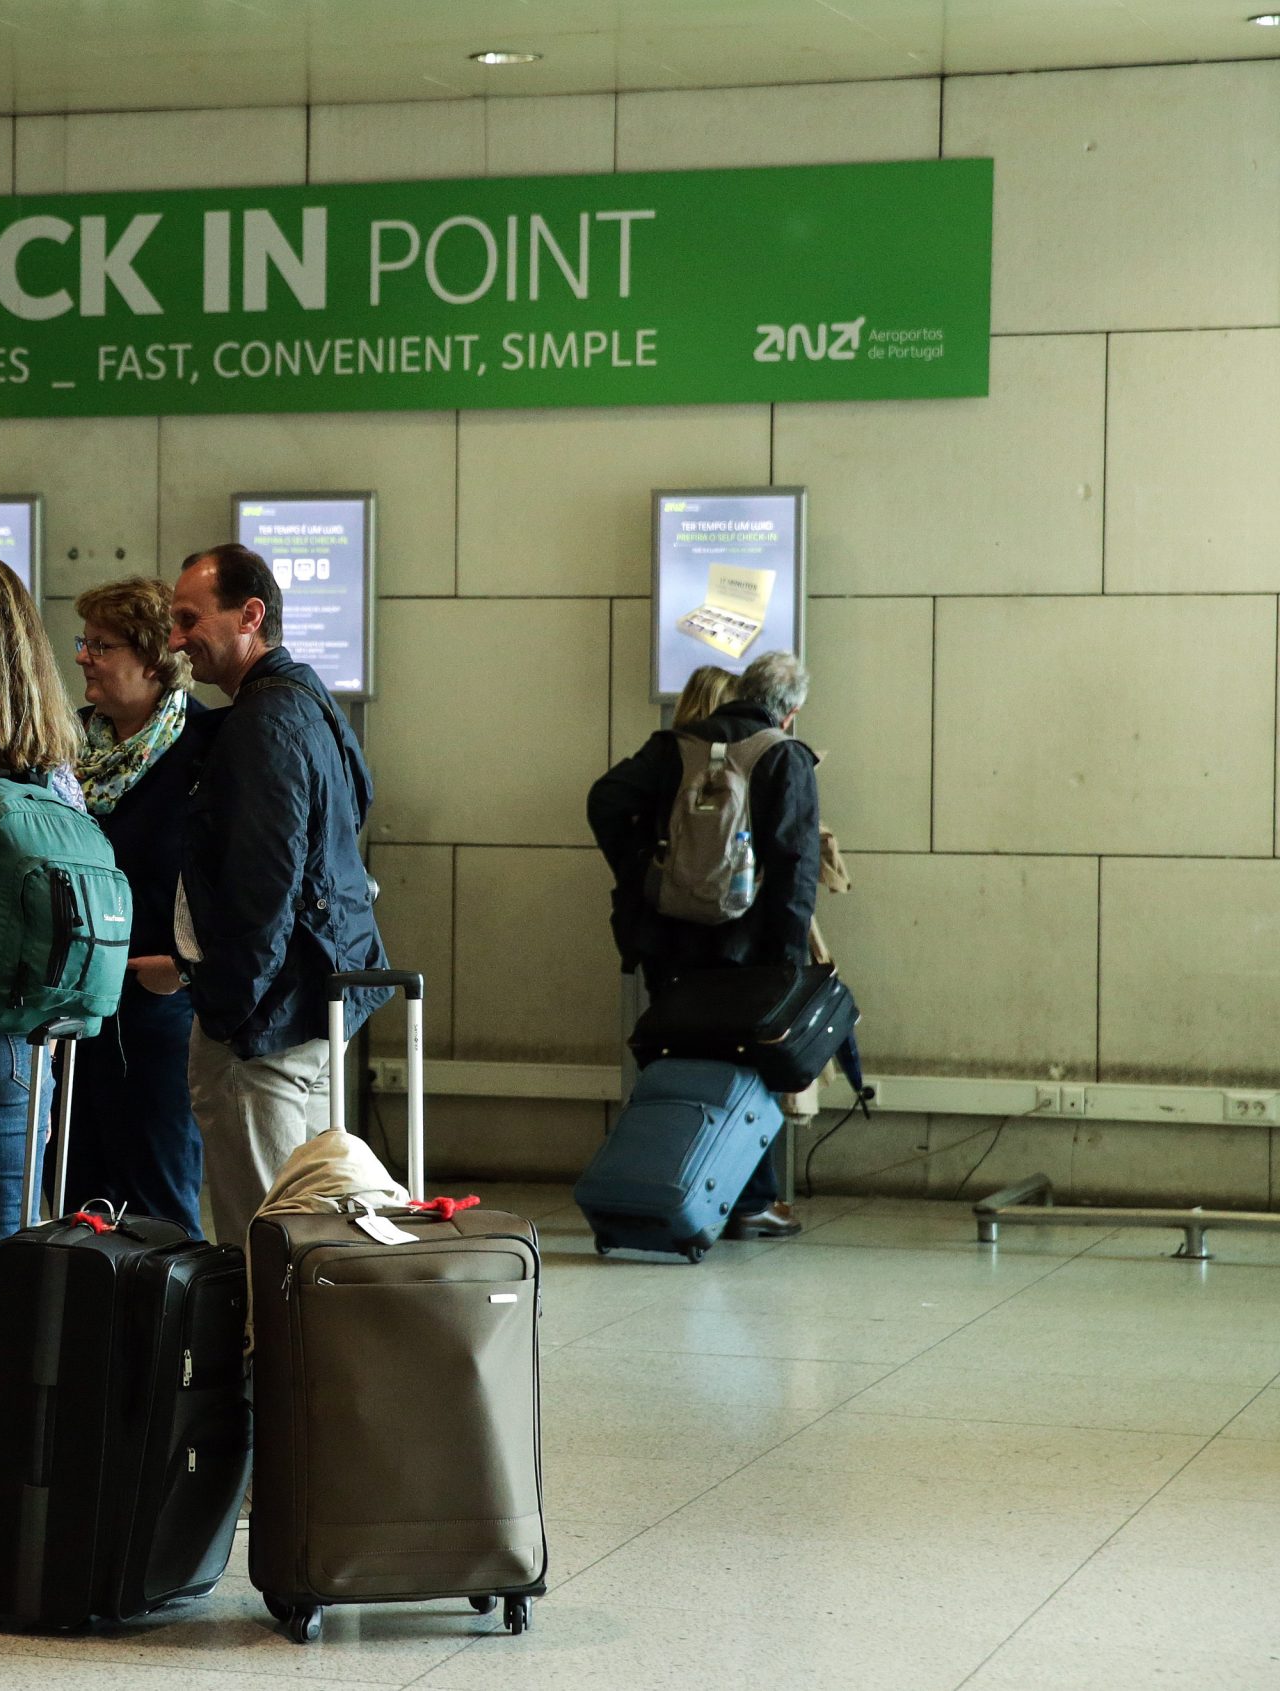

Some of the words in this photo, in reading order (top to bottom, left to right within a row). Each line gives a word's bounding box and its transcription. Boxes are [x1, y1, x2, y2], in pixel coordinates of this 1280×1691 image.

[203, 207, 328, 314] IN
[370, 209, 657, 307] POINT
[868, 345, 884, 359] de
[888, 345, 944, 361] Portugal
[869, 328, 944, 343] Aeroportos
[98, 344, 198, 384] FAST,
[213, 333, 487, 380] CONVENIENT,
[501, 328, 658, 372] SIMPLE
